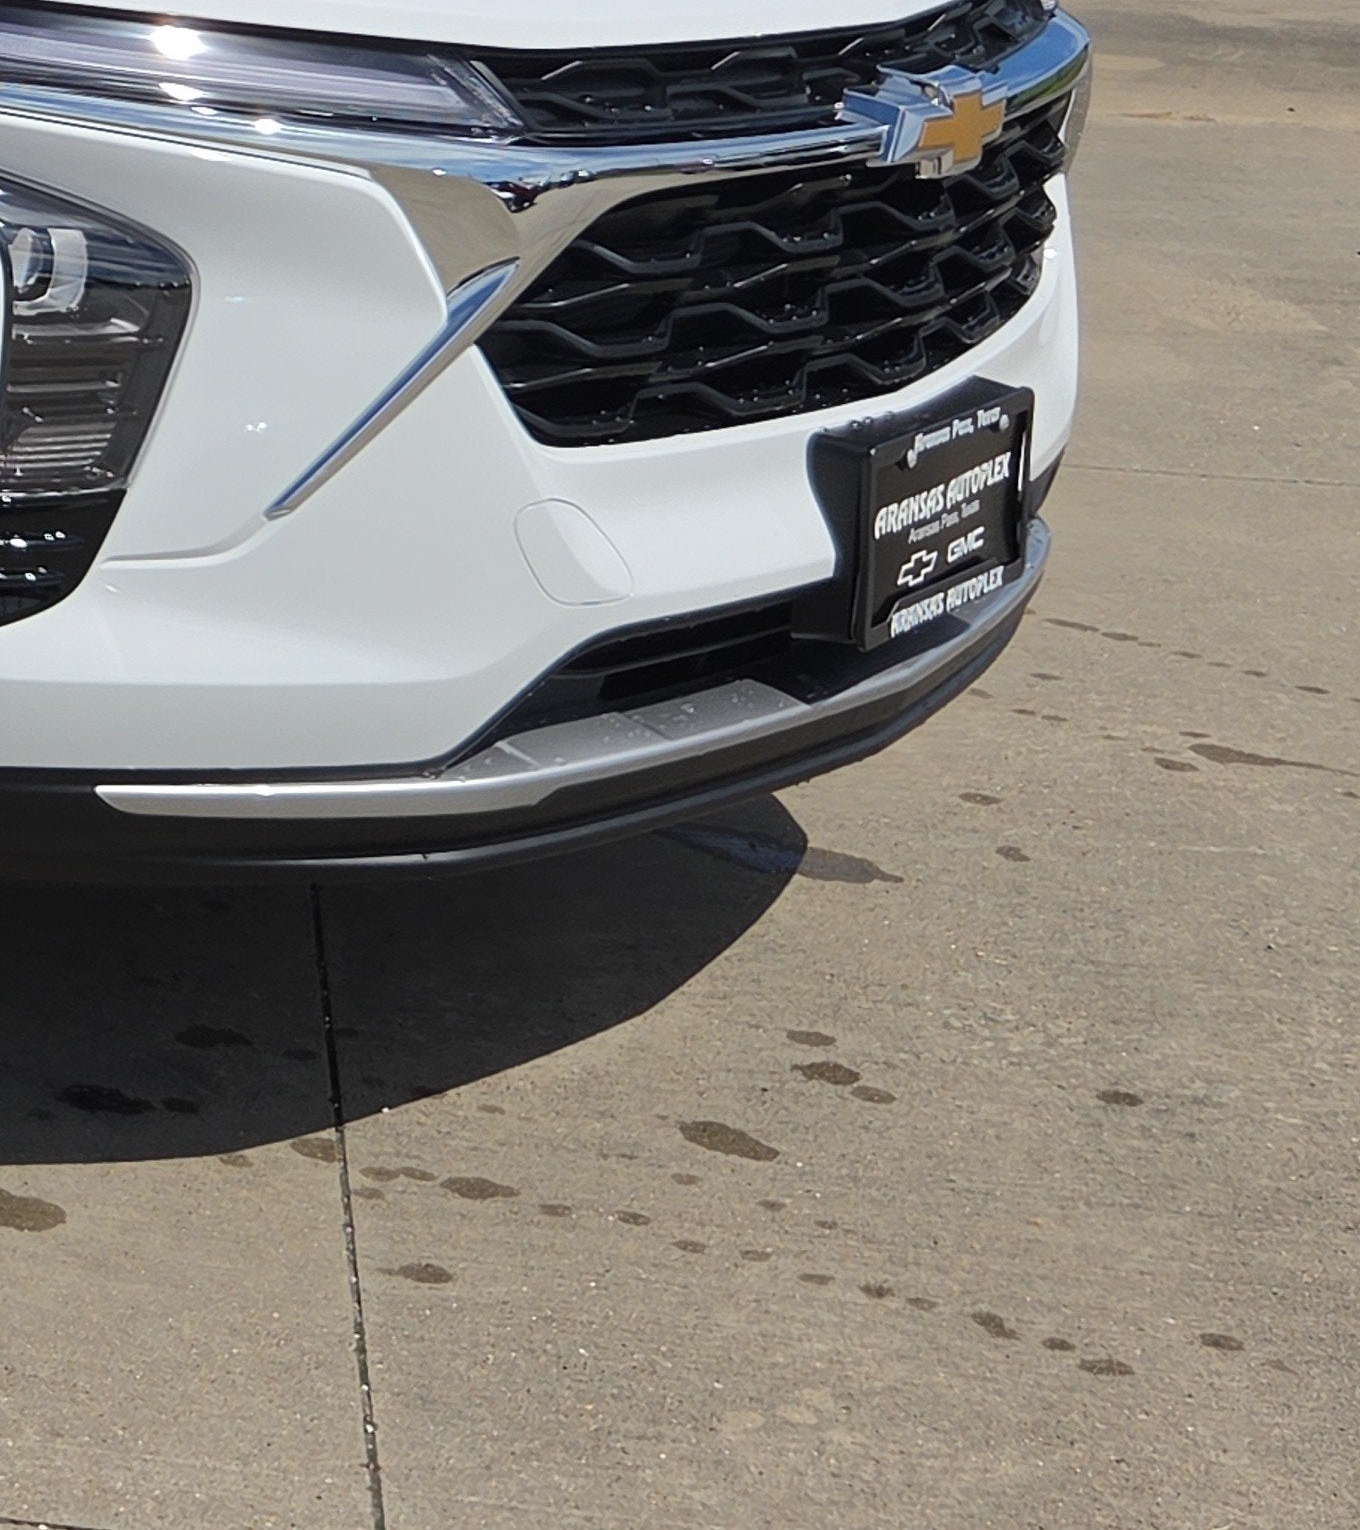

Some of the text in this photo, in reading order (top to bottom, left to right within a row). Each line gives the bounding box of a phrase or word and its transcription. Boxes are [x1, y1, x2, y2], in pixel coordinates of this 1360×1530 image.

[874, 483, 945, 540] ARANSAS
[946, 451, 1011, 509] AUTOPLEX
[947, 526, 985, 563] GMC
[890, 565, 1004, 638] ARANSAS AUTOPLEX
